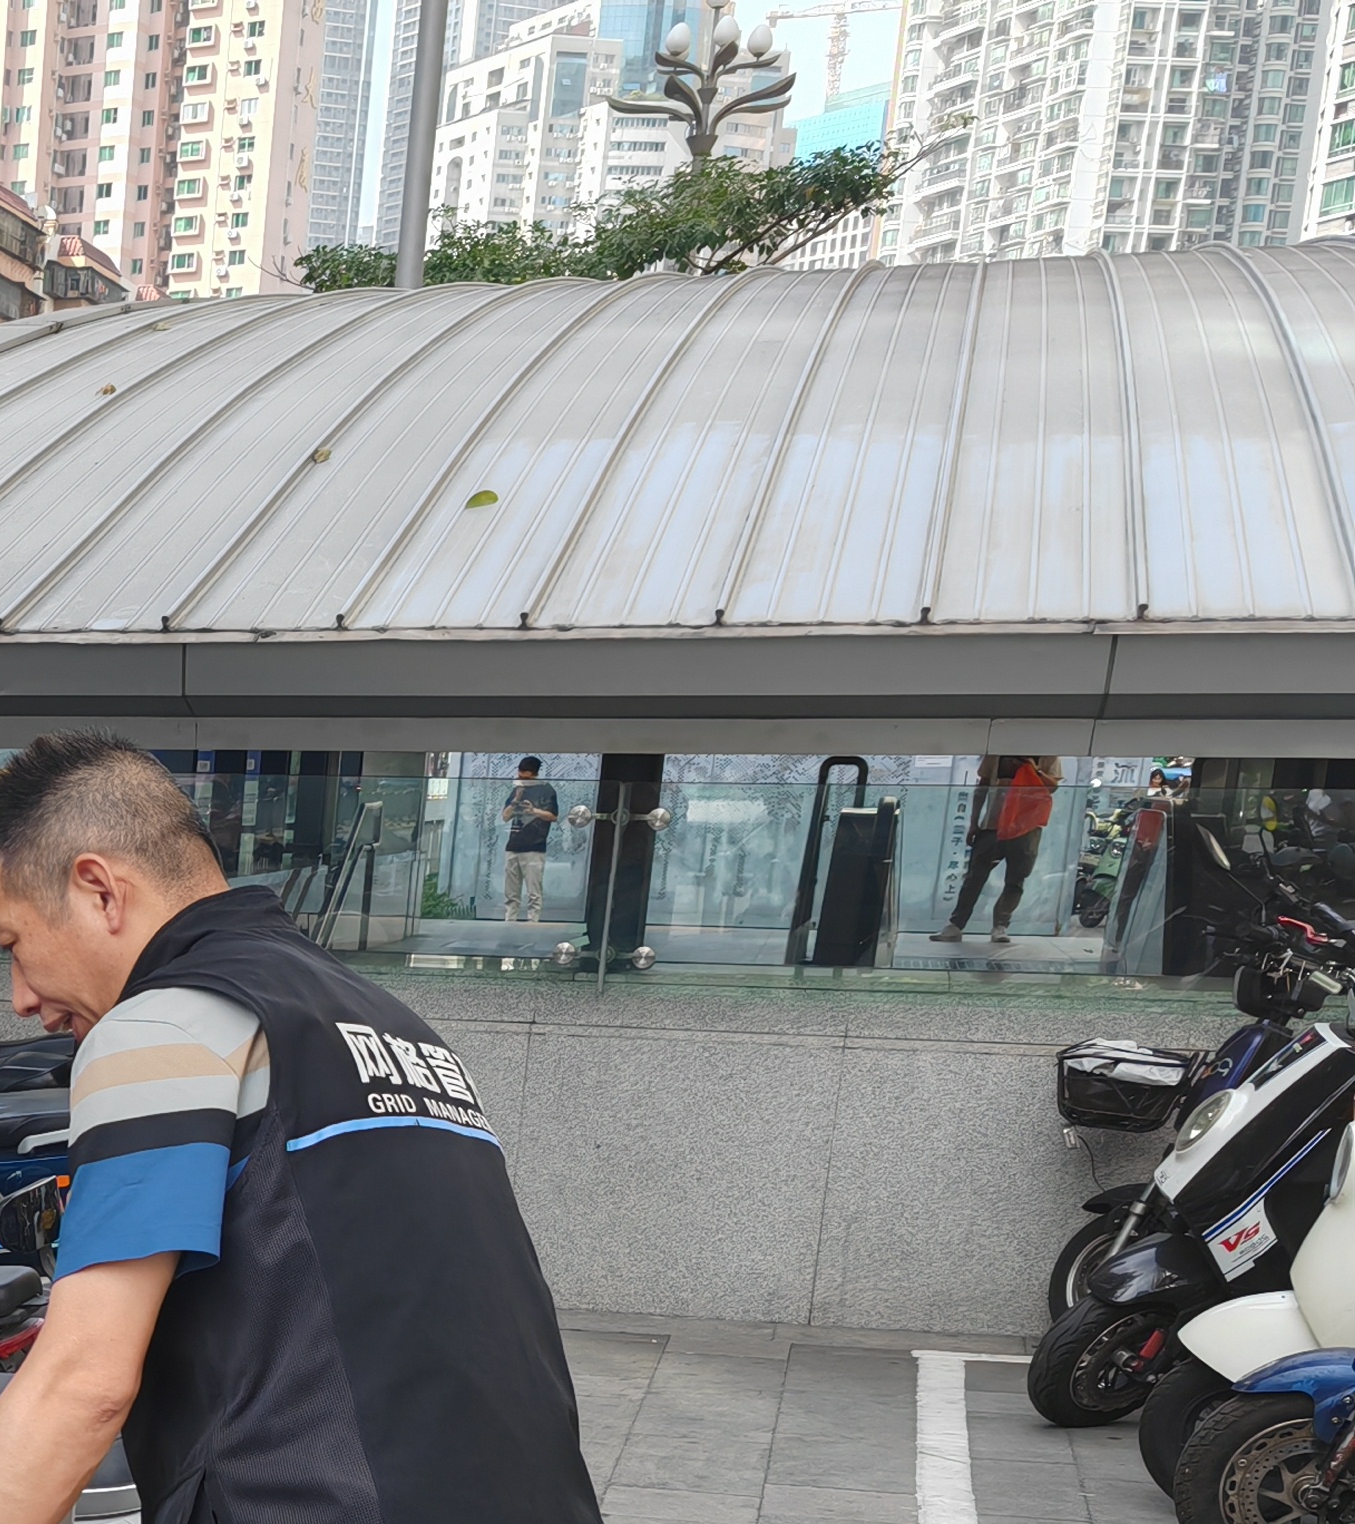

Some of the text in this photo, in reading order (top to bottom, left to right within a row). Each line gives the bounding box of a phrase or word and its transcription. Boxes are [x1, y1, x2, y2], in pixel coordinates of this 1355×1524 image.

[335, 1022, 485, 1105] 网格管
[367, 1092, 417, 1114] GRID
